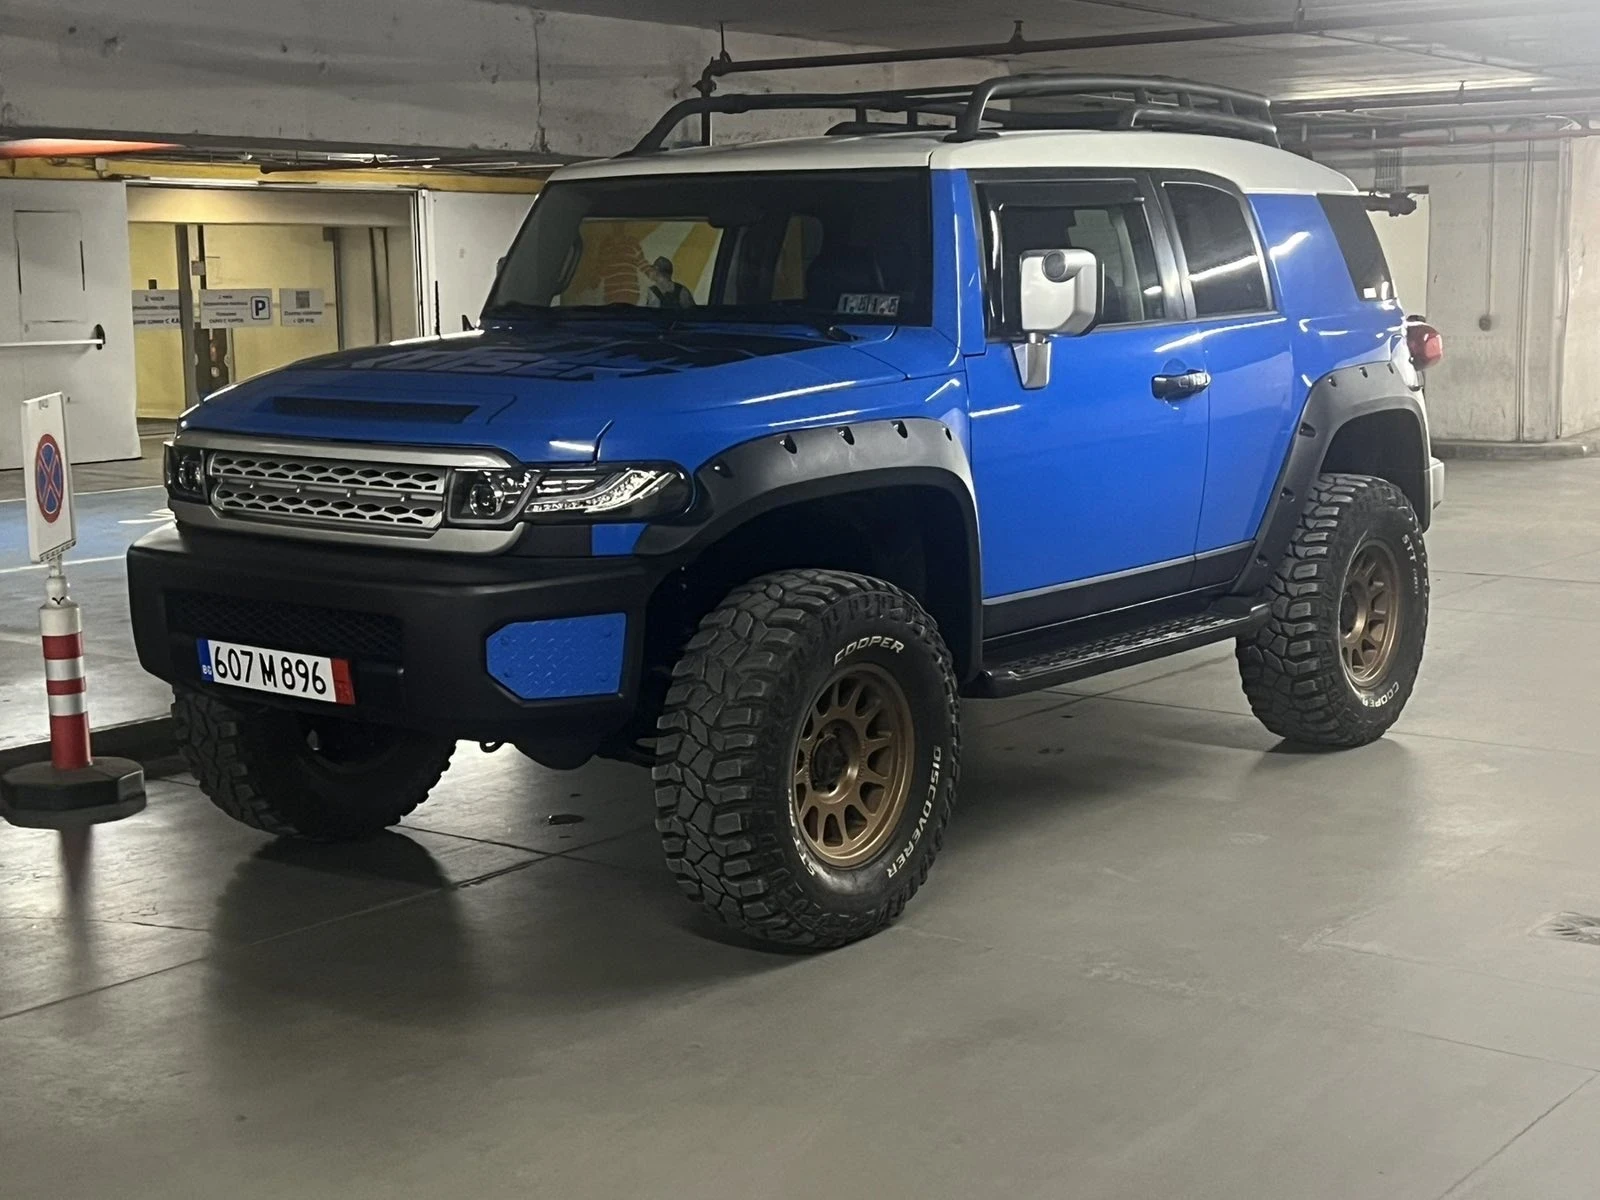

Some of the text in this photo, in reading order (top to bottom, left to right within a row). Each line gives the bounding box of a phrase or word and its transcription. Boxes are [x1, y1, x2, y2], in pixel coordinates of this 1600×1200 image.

[254, 300, 266, 316] P
[833, 635, 905, 666] COOPER
[202, 664, 213, 675] BG
[215, 646, 253, 683] 607
[258, 652, 278, 688] M
[281, 656, 327, 695] 896
[1361, 681, 1400, 708] COOPER
[886, 746, 943, 878] DISCOVERER
